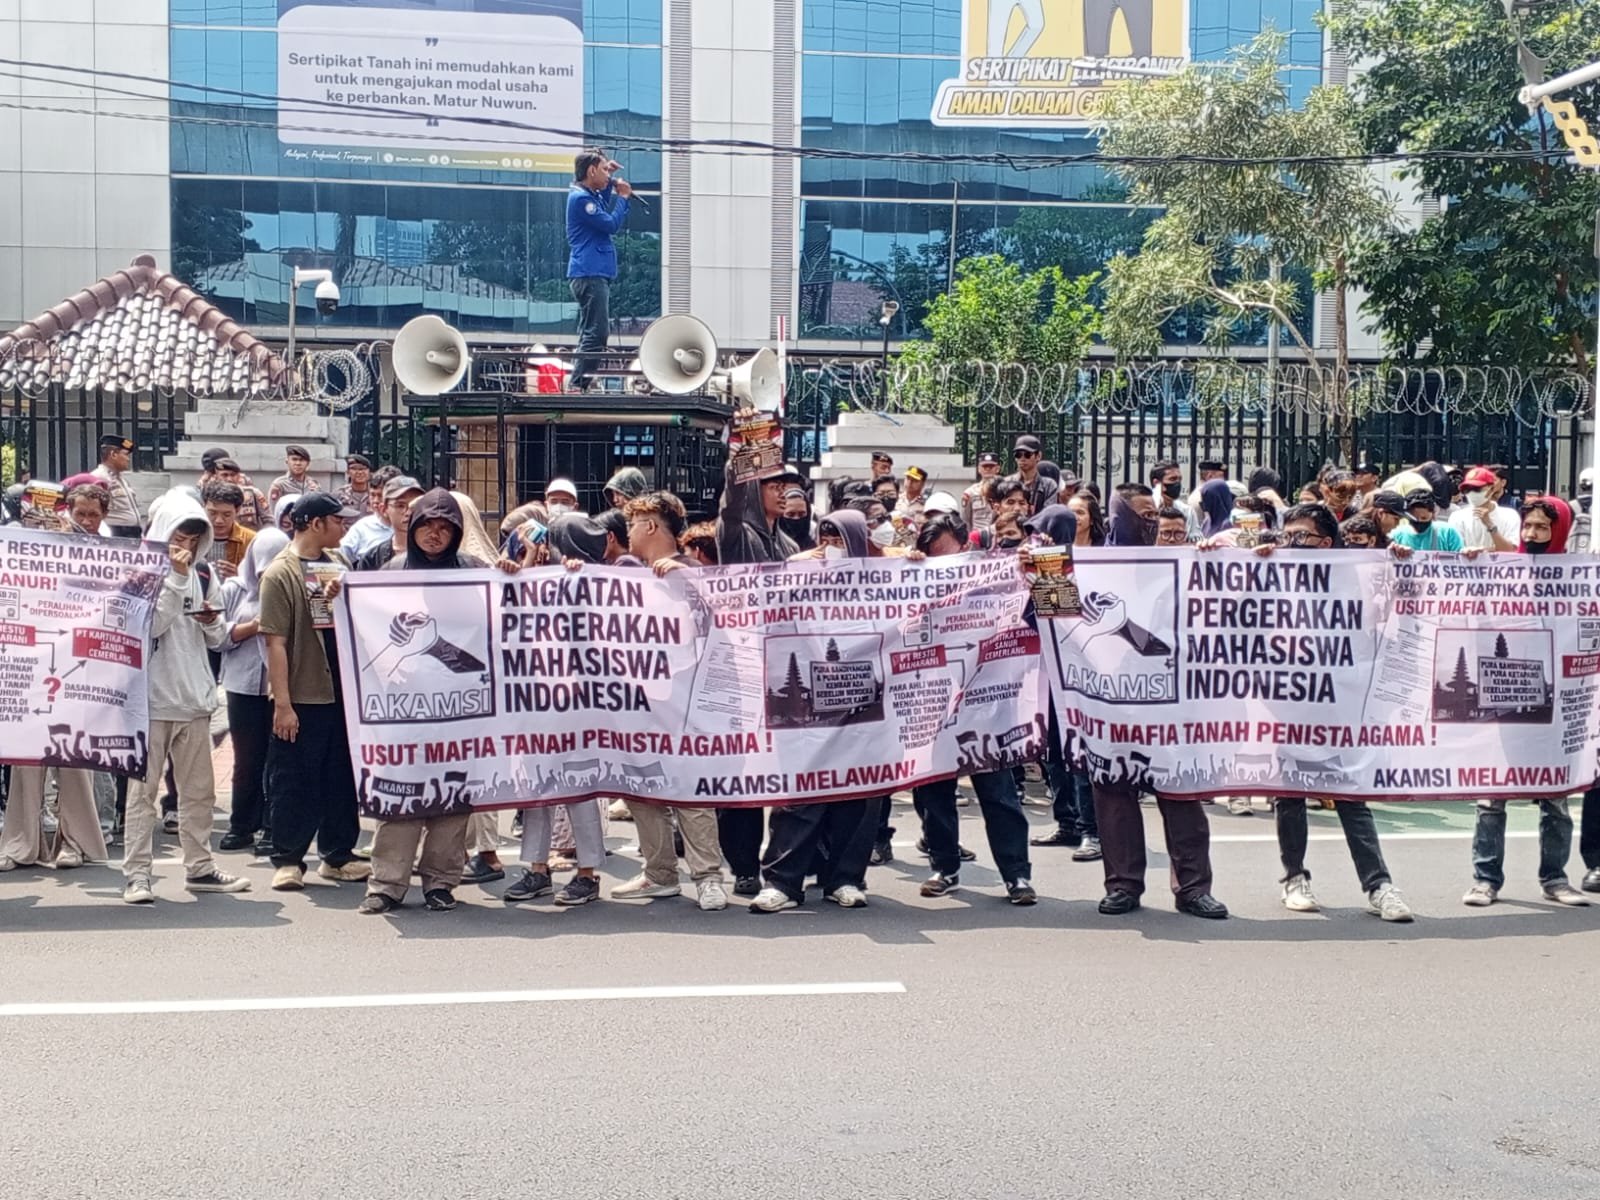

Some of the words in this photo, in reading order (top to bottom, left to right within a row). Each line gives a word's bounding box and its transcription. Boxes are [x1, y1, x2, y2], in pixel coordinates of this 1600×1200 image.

[288, 52, 363, 68] Sertipikat
[367, 56, 411, 71] Tanah
[414, 58, 433, 71] ini
[436, 60, 535, 75] memudahkan
[539, 63, 574, 77] kami
[968, 57, 1073, 81] SERTIPIKAT
[314, 72, 359, 86] untuk
[362, 74, 452, 91] mengajukan
[456, 78, 501, 92] modal
[505, 81, 549, 94] usaha
[326, 89, 344, 102] ke
[347, 91, 431, 107] perbankan.
[433, 95, 478, 108] Matur
[481, 97, 537, 111] Nuwun.
[949, 91, 1005, 116] AMAN
[1009, 91, 1075, 116] DALAM
[8, 541, 63, 559] RESTU
[68, 546, 165, 566] MAHARANI
[7, 558, 120, 580] CEMERLANG!
[707, 576, 760, 594] TOLAK
[762, 571, 855, 588] SERTIFIKAT
[858, 568, 892, 584] HGB
[900, 568, 921, 583] PT
[925, 565, 976, 581] RESTU
[1187, 561, 1331, 593] ANGKATAN
[1393, 564, 1440, 578] TOLAK
[1443, 565, 1525, 580] SERTIFIKAT
[1528, 566, 1562, 579] HGB
[1571, 566, 1592, 579] PT
[500, 577, 644, 608] ANGKATAN
[747, 593, 759, 607] &
[766, 590, 786, 604] PT
[789, 587, 861, 603] KARTIKA
[864, 586, 921, 601] SANUR
[925, 567, 1015, 599] CEMERLANG!
[1427, 582, 1438, 596] &
[1445, 583, 1464, 596] PT
[1465, 583, 1529, 597] KARTIKA
[1534, 584, 1592, 598] SANUR
[38, 600, 83, 611] PERALIHAN
[714, 611, 759, 629] USUT
[763, 606, 816, 624] MAFIA
[821, 605, 880, 621] TANAH
[885, 604, 903, 619] DI
[1187, 598, 1363, 630] PERGERAKAN
[1396, 600, 1435, 615] USUT
[1438, 601, 1487, 616] MAFIA
[1491, 601, 1549, 616] TANAH
[1554, 602, 1572, 616] DI
[501, 612, 681, 645] PERGERAKAN
[945, 612, 986, 624] PERALIHAN
[75, 630, 87, 638] PT
[994, 639, 1018, 650] SANUR
[88, 650, 132, 664] CEMERLANG
[100, 641, 125, 652] SANUR
[913, 648, 936, 659] RESTU
[984, 646, 1026, 661] CEMERLANG
[1187, 634, 1354, 667] MAHASISWA
[13, 656, 39, 665] WARIS
[502, 648, 671, 680] MAHASISWA
[928, 678, 952, 688] WARIS
[1066, 664, 1175, 700] AKAMSI
[1186, 669, 1336, 703] INDONESIA
[363, 687, 491, 721] AKAMSI
[504, 681, 651, 713] INDONESIA
[894, 691, 915, 701] TIDAK
[917, 688, 948, 699] PERNAH
[1066, 708, 1106, 740] UUT
[1110, 723, 1179, 746] MAFIA
[1183, 721, 1249, 745] TANAH
[1256, 722, 1351, 748] PENISTA
[1358, 725, 1425, 747] AGAMA
[98, 738, 130, 748] AKAMSI
[361, 744, 418, 766] USUT
[425, 737, 497, 763] MAFIA
[502, 732, 576, 755] TANAH
[583, 729, 674, 755] PENISTA
[678, 731, 760, 757] AGAMA
[377, 780, 416, 795] AKAMSI
[694, 773, 788, 796] AKAMSI
[796, 760, 916, 793] MELAWAN!
[1373, 768, 1451, 788] AKAMSI
[1458, 765, 1571, 787] MELAWAN!
